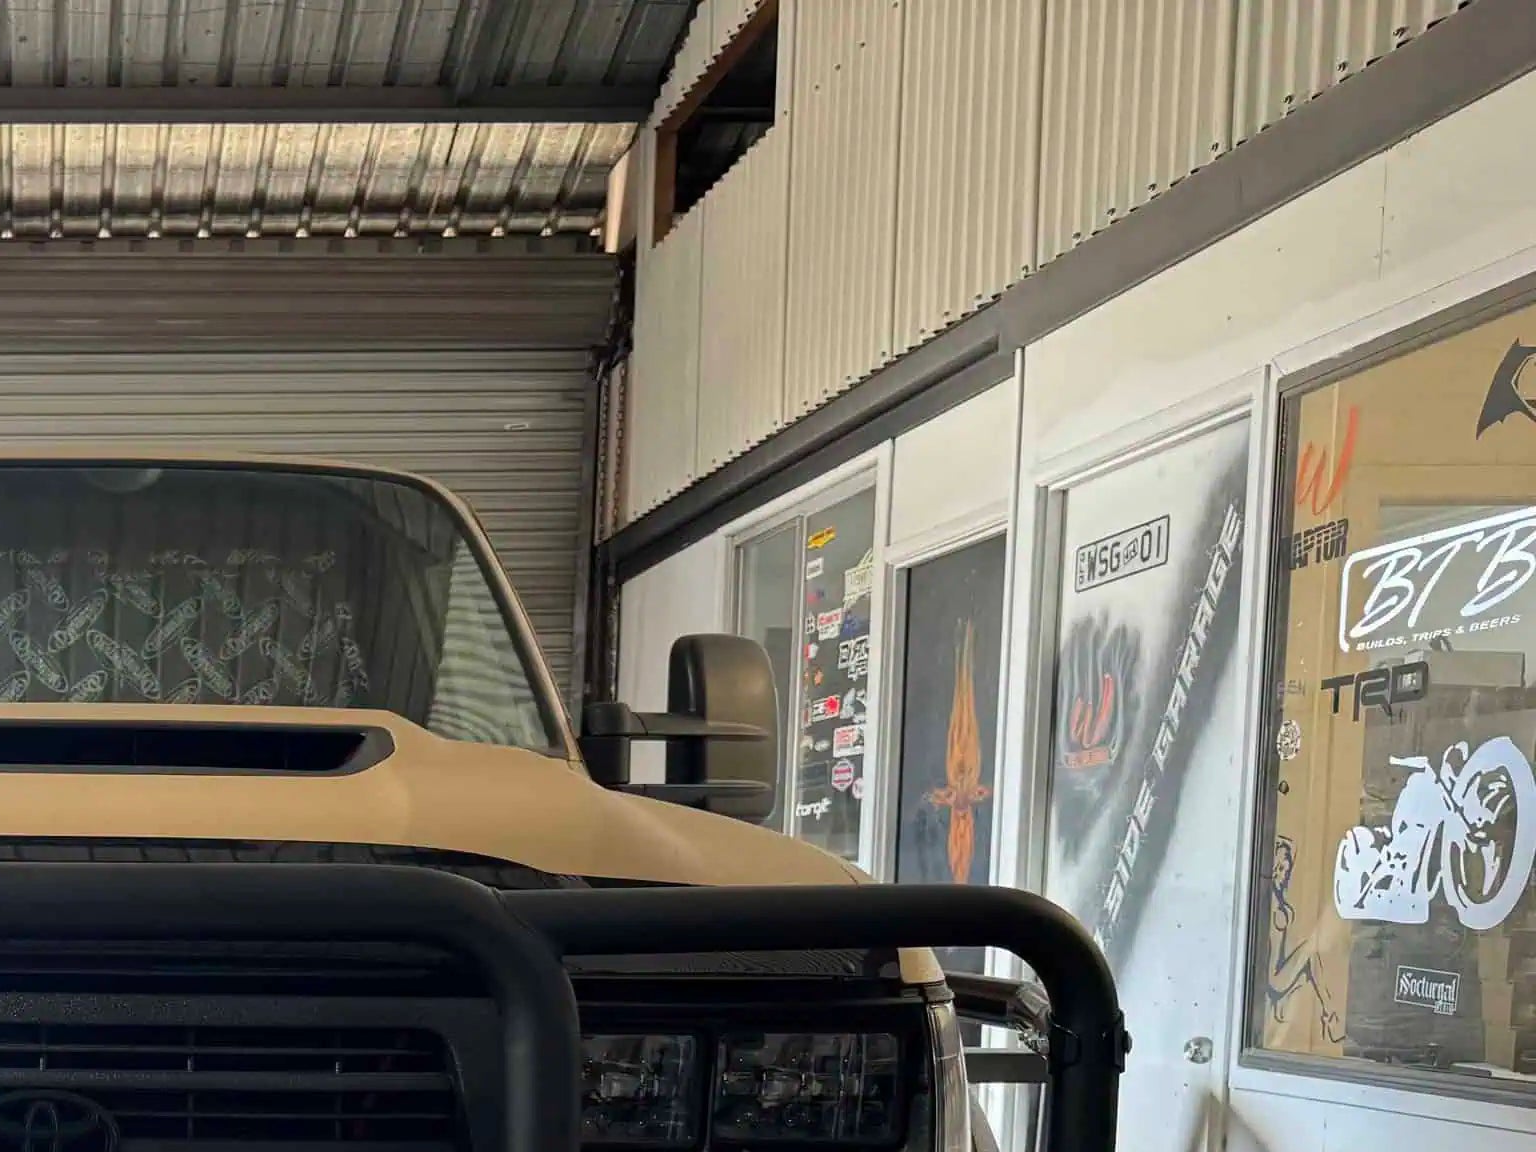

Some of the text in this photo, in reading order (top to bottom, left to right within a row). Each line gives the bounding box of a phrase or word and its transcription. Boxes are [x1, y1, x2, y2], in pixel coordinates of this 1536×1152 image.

[1087, 541, 1121, 581] WSG
[1152, 503, 1241, 772] GARAGE
[1412, 626, 1453, 642] TRIPS
[1469, 613, 1522, 633] BEERS
[1320, 661, 1429, 722] TRD
